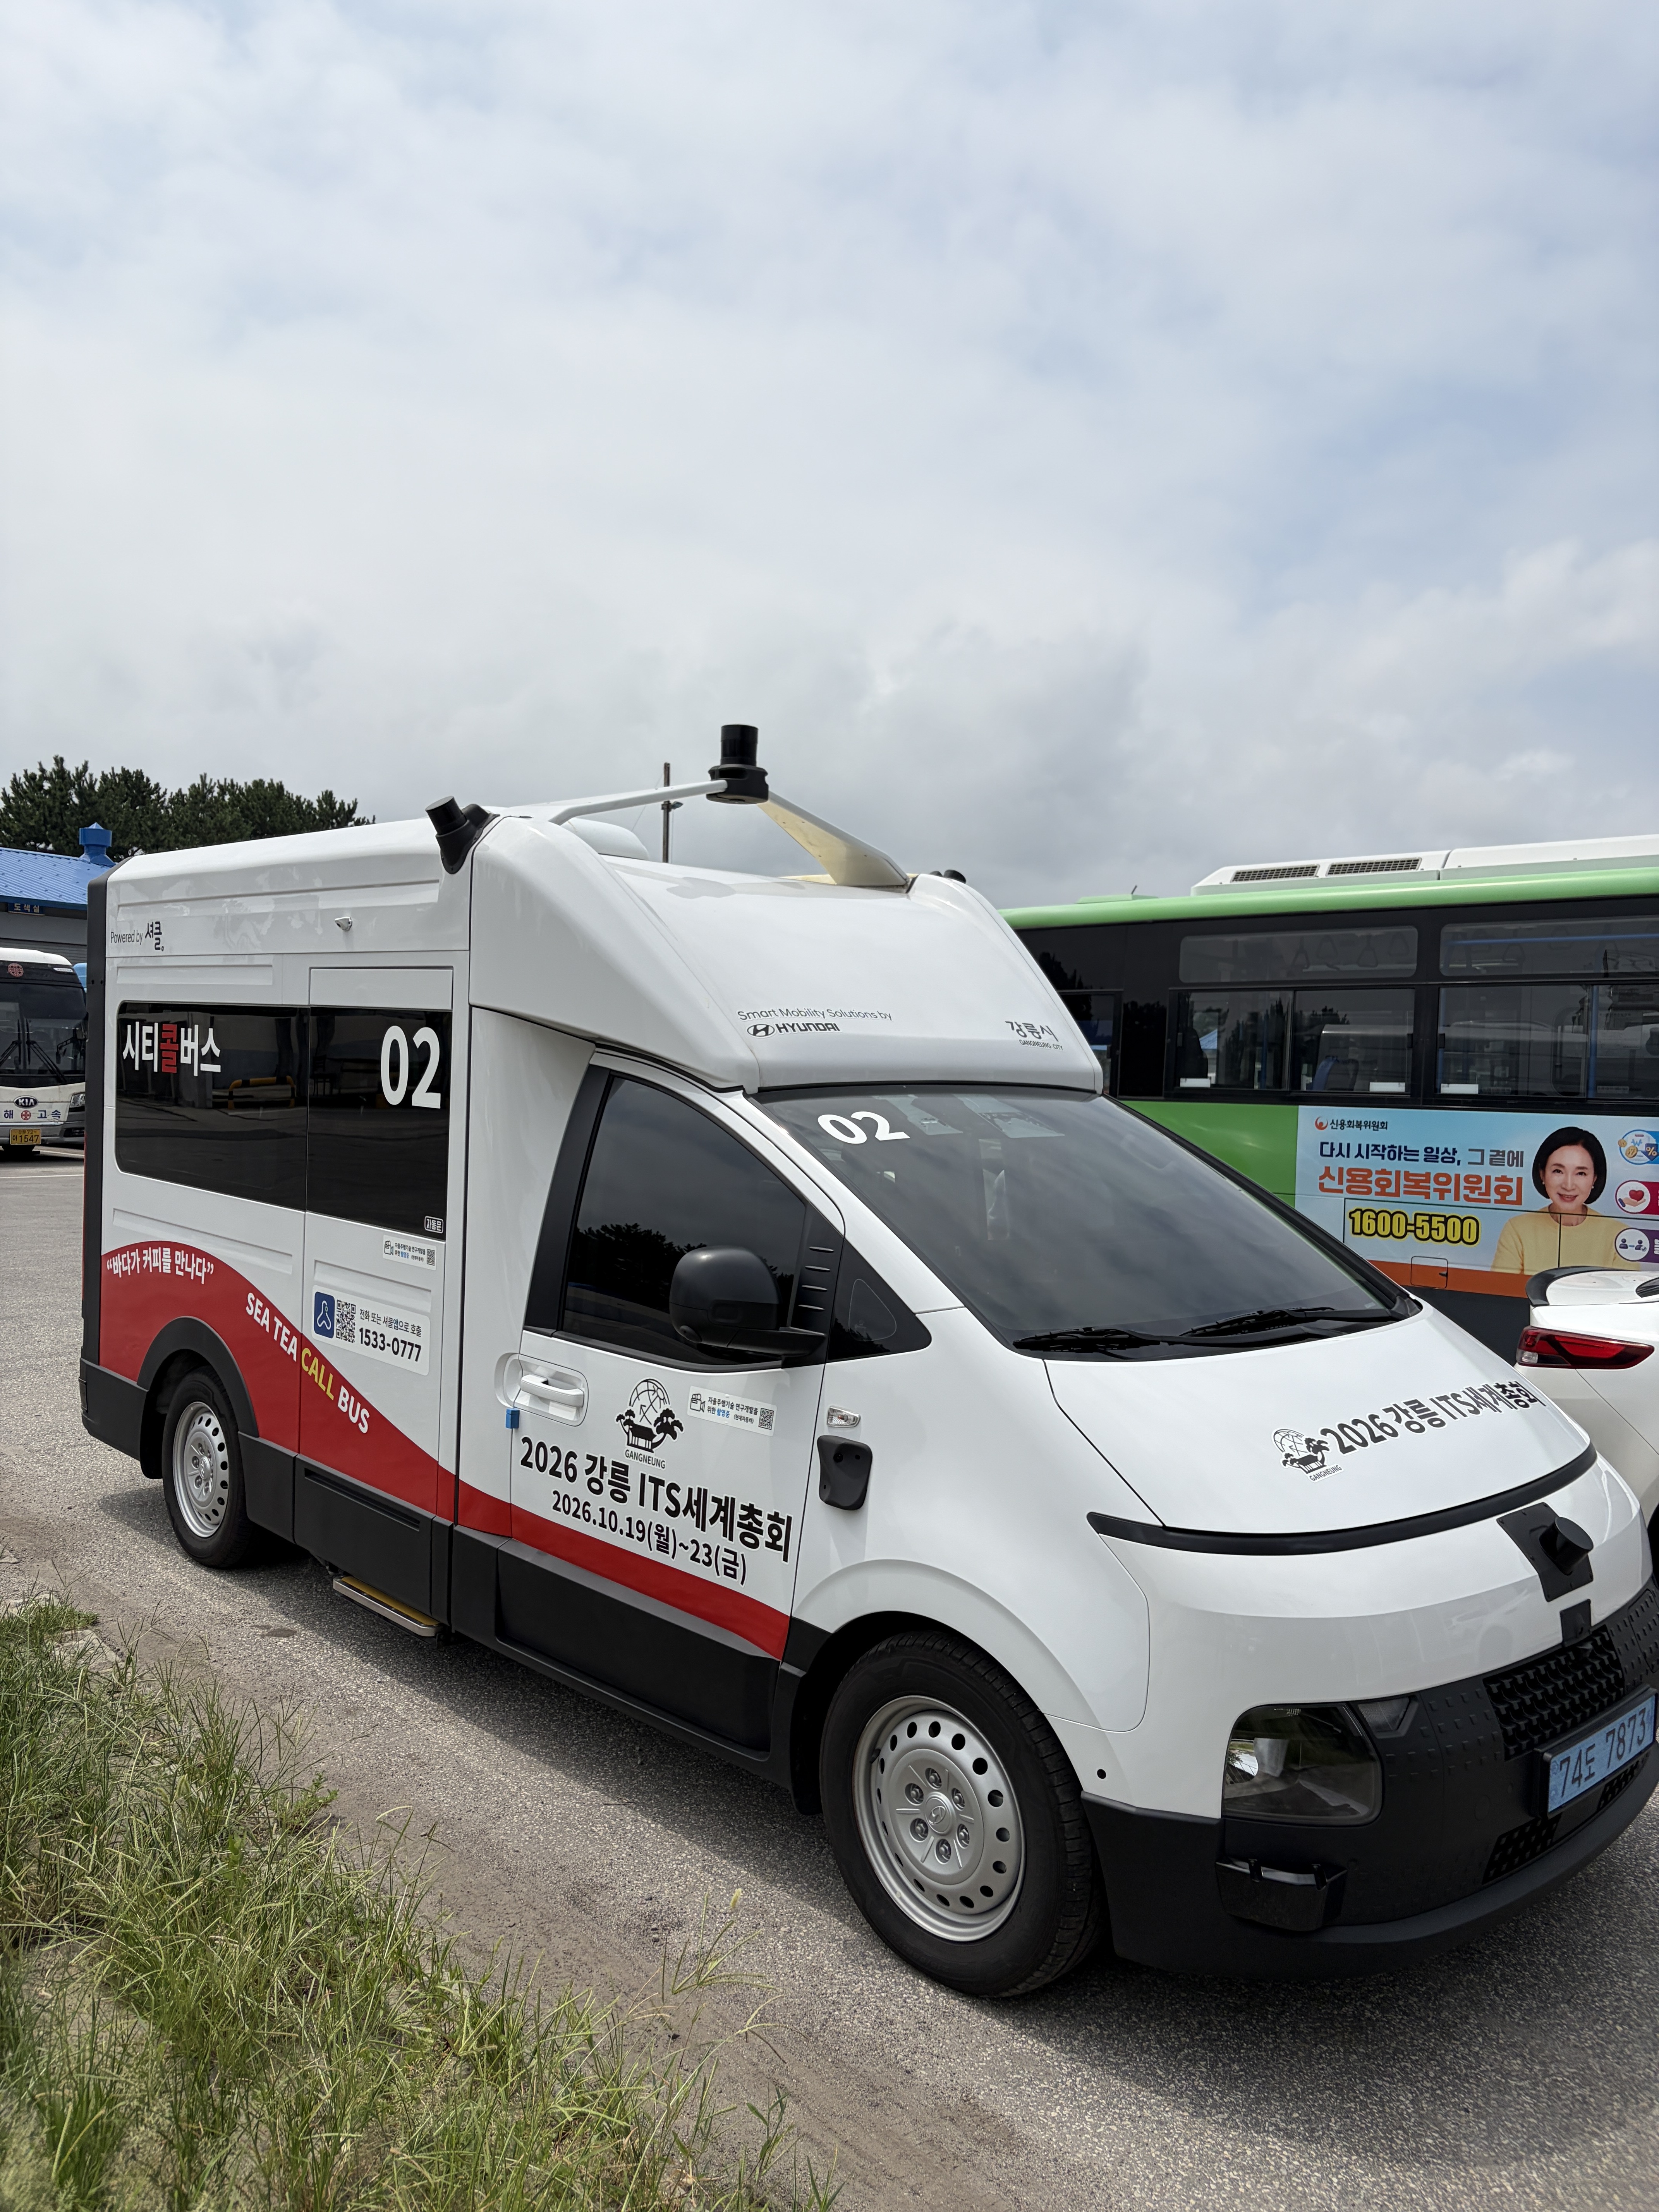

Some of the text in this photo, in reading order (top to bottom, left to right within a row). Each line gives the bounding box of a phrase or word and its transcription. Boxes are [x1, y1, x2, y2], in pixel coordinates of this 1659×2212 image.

[110, 929, 135, 943] Powered
[136, 929, 143, 945] by
[737, 1008, 892, 1021] Smart Mobility Solutions by
[775, 1023, 841, 1034] HYUNDAI
[1005, 1021, 1059, 1042] 강릉시
[123, 1021, 221, 1077] 시티콜버스
[1019, 1039, 1051, 1049] GANGNEUNG
[381, 1025, 441, 1109] 02
[4, 1109, 14, 1119] 해
[1330, 1119, 1388, 1131] 신용회복위원회
[19, 1135, 39, 1143] 1547
[817, 1111, 910, 1145] 02
[1320, 1141, 1524, 1168] 다시 시작하는 일상, 그 곁에
[1319, 1166, 1523, 1206] 신용회복위원회
[426, 1218, 442, 1231] 자동문
[1349, 1208, 1479, 1245] 1600-5500
[143, 1247, 172, 1274] 커피를
[359, 1309, 370, 1322] 전화
[371, 1312, 381, 1325] 또는
[410, 1324, 422, 1338] 호출
[359, 1327, 422, 1362] 1533-0777
[246, 1292, 370, 1434] SEA TEA CALL BUS
[707, 1406, 716, 1415] 위한
[733, 1414, 754, 1424] (현대자동차)
[708, 1396, 758, 1416] 자율주행기술 연구개발을
[1320, 1381, 1547, 1455] 2026 강릉 ITS세계총회
[625, 1449, 666, 1469] GANGNEUNG
[1309, 1465, 1342, 1482] GANGNEUNG
[520, 1437, 792, 1563] 2026 강릉 ITS세계총회
[552, 1490, 746, 1586] 2026.10.19(월)~23(금)
[1559, 1707, 1646, 1798] 74도 7873
